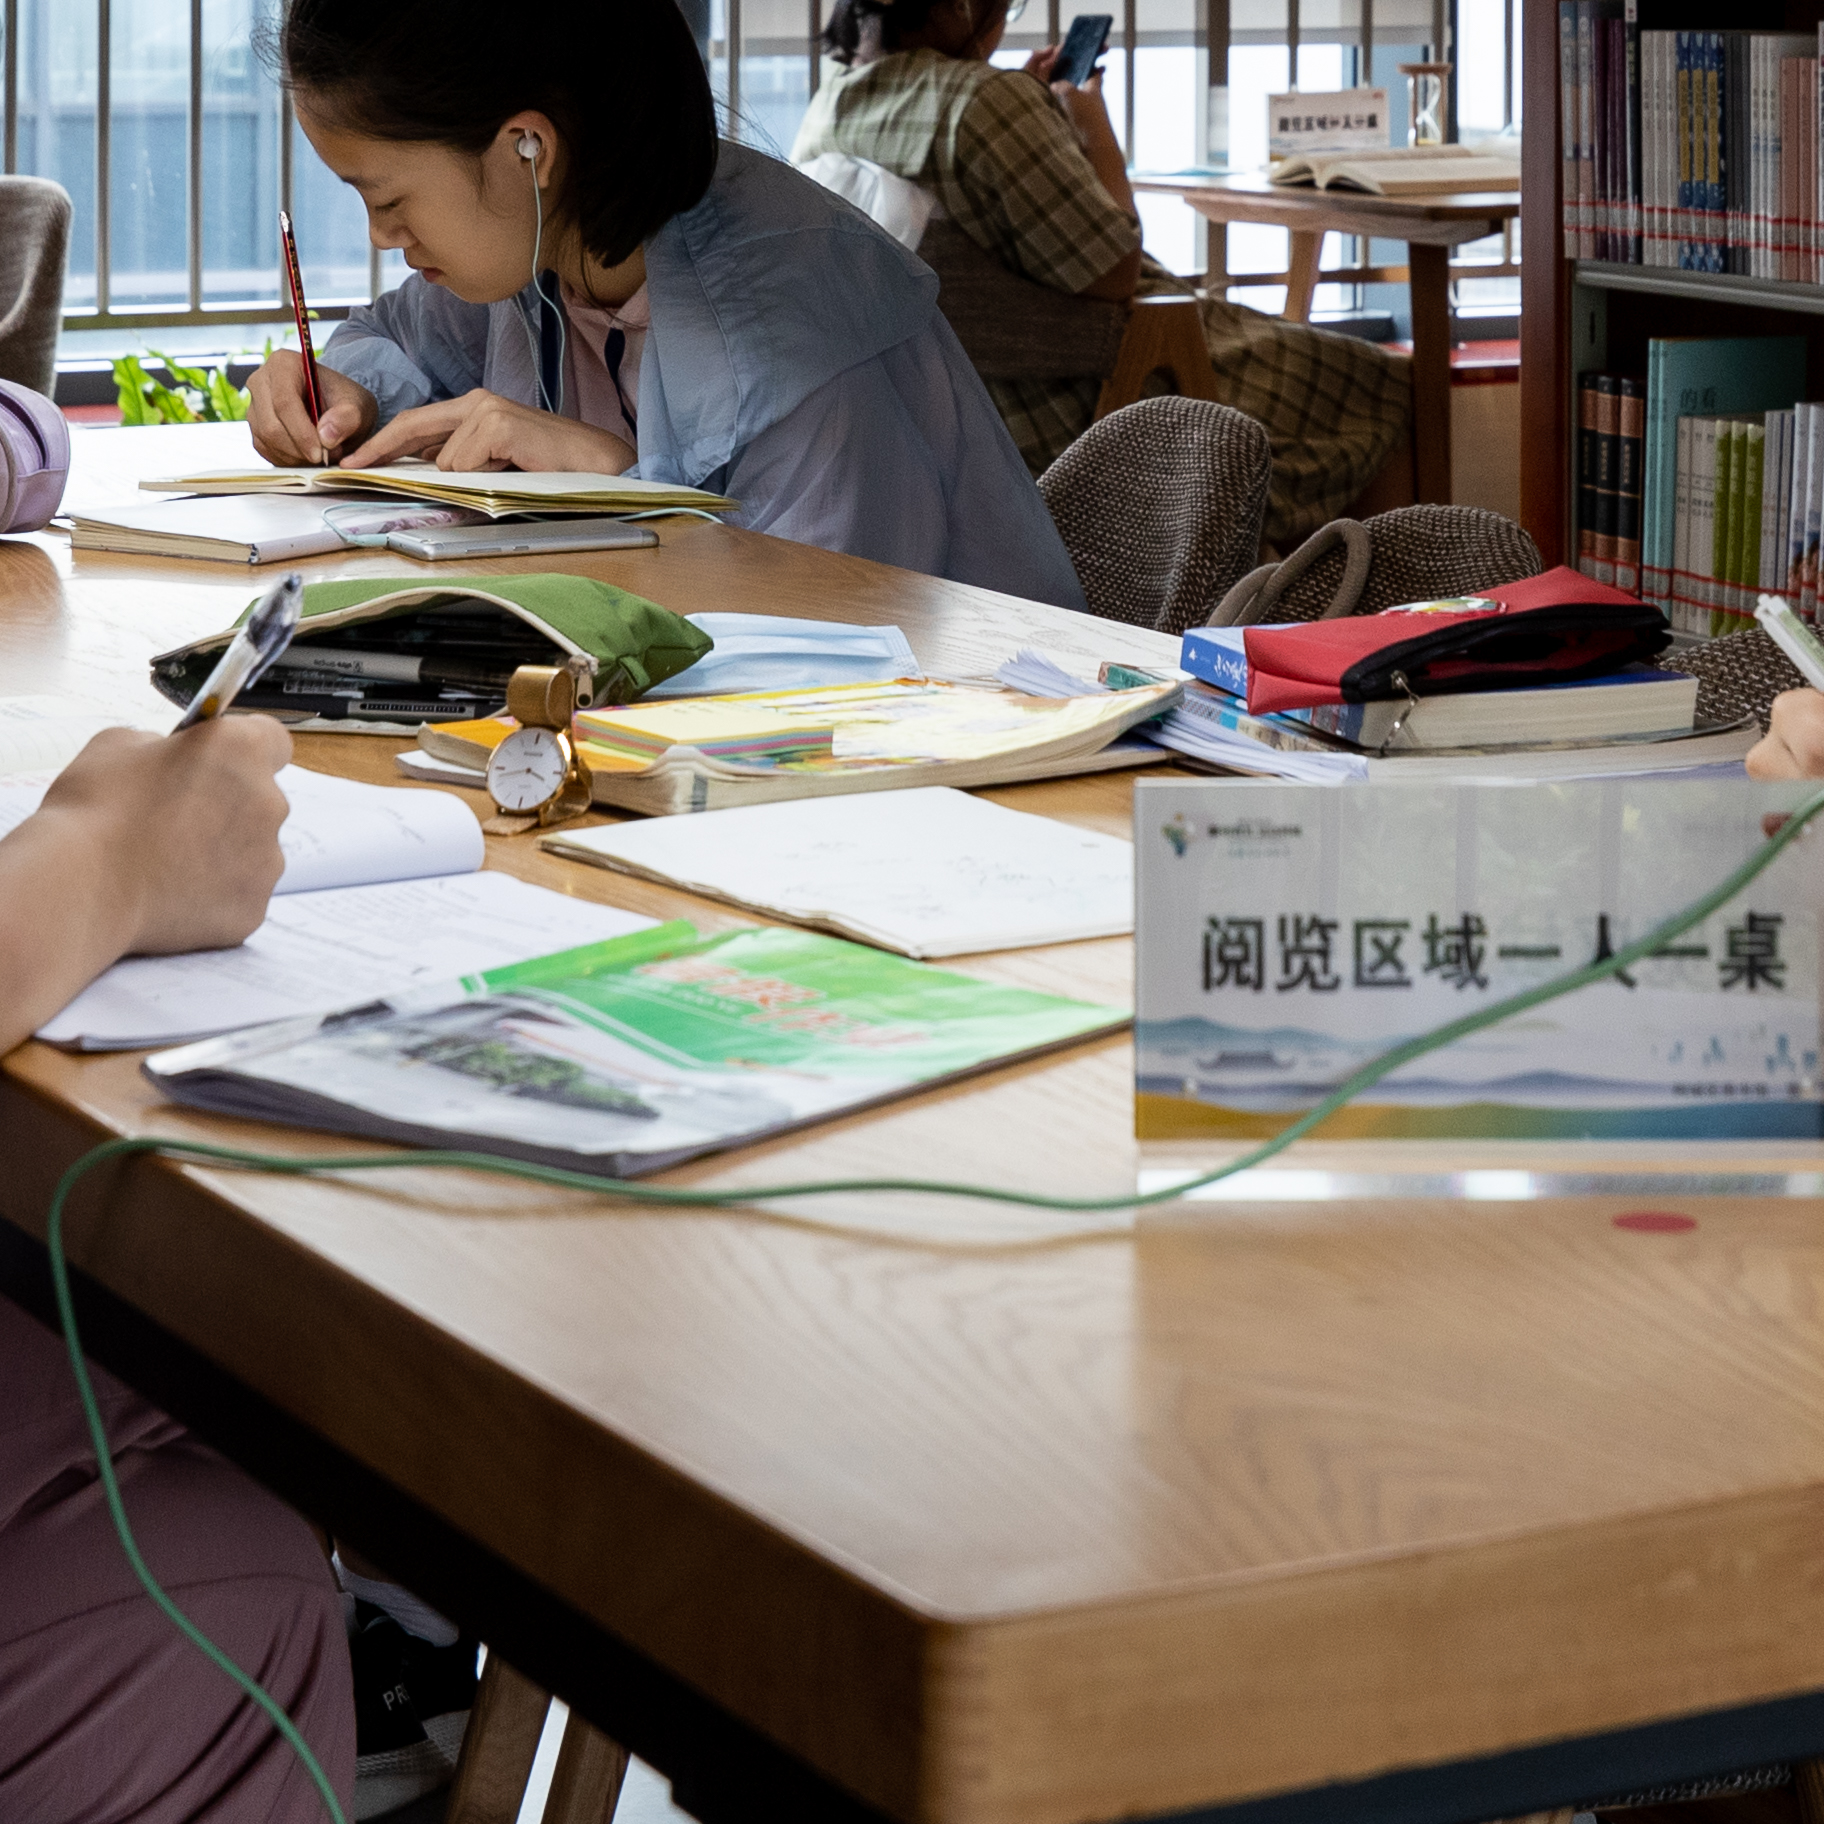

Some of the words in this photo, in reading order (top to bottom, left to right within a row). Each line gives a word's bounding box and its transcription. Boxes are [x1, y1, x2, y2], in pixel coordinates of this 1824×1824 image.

[1201, 912, 1788, 995] 阅览区域一人一桌
